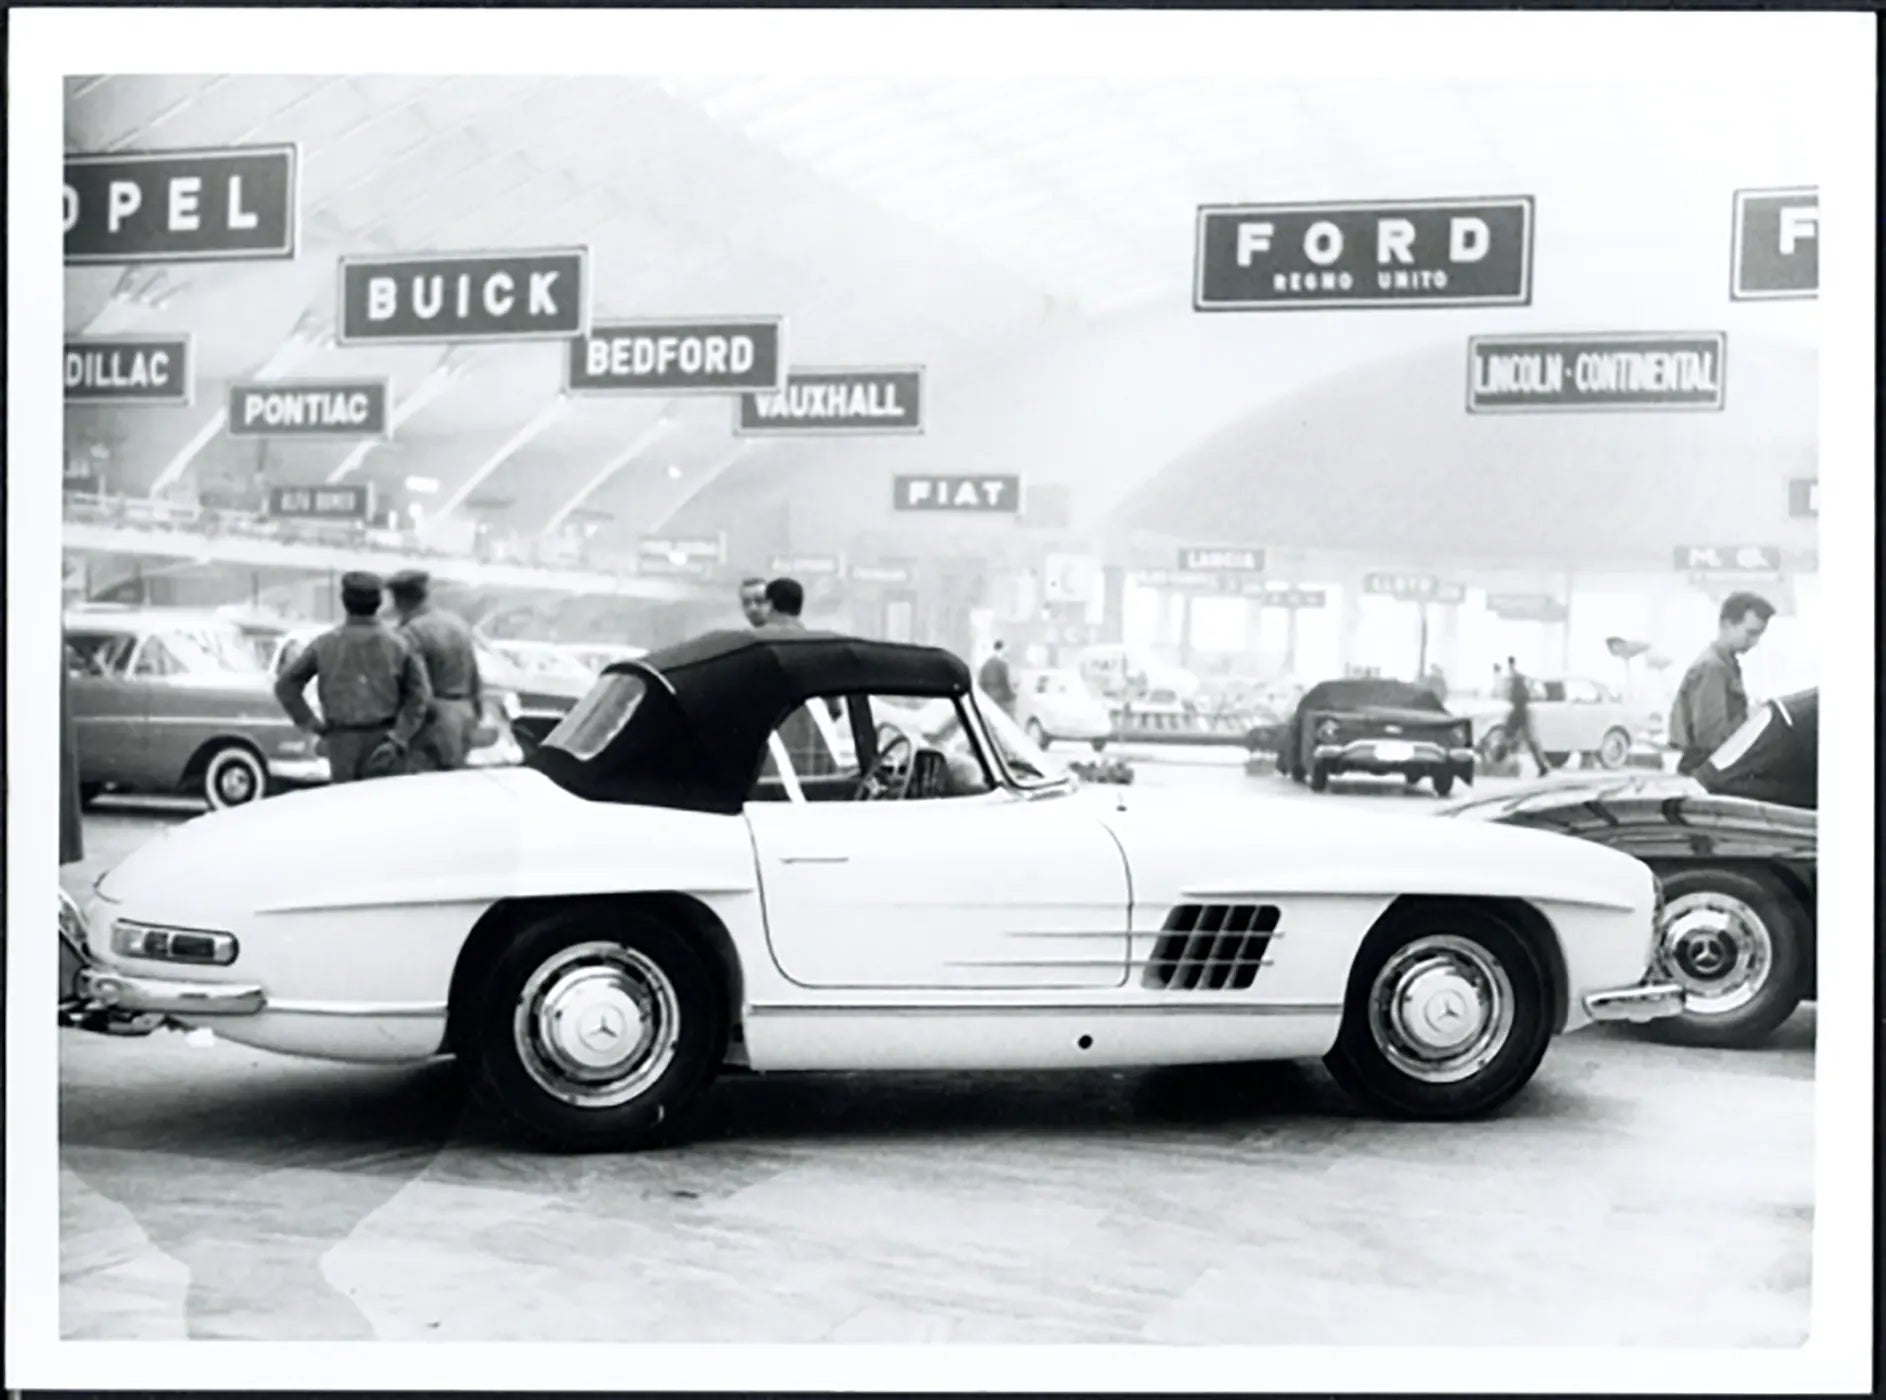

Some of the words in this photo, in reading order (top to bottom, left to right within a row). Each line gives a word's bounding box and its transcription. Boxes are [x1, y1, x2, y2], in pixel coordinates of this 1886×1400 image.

[1237, 217, 1490, 268] FORD
[1779, 206, 1818, 255] F
[368, 271, 559, 320] BUICK
[1273, 272, 1354, 292] REGNO
[1377, 270, 1448, 290] UNITO
[587, 336, 753, 375] BEDFORD
[245, 392, 368, 425] PONTIAC
[755, 383, 905, 418] VAUXHALL
[909, 481, 1004, 505] FIAT
